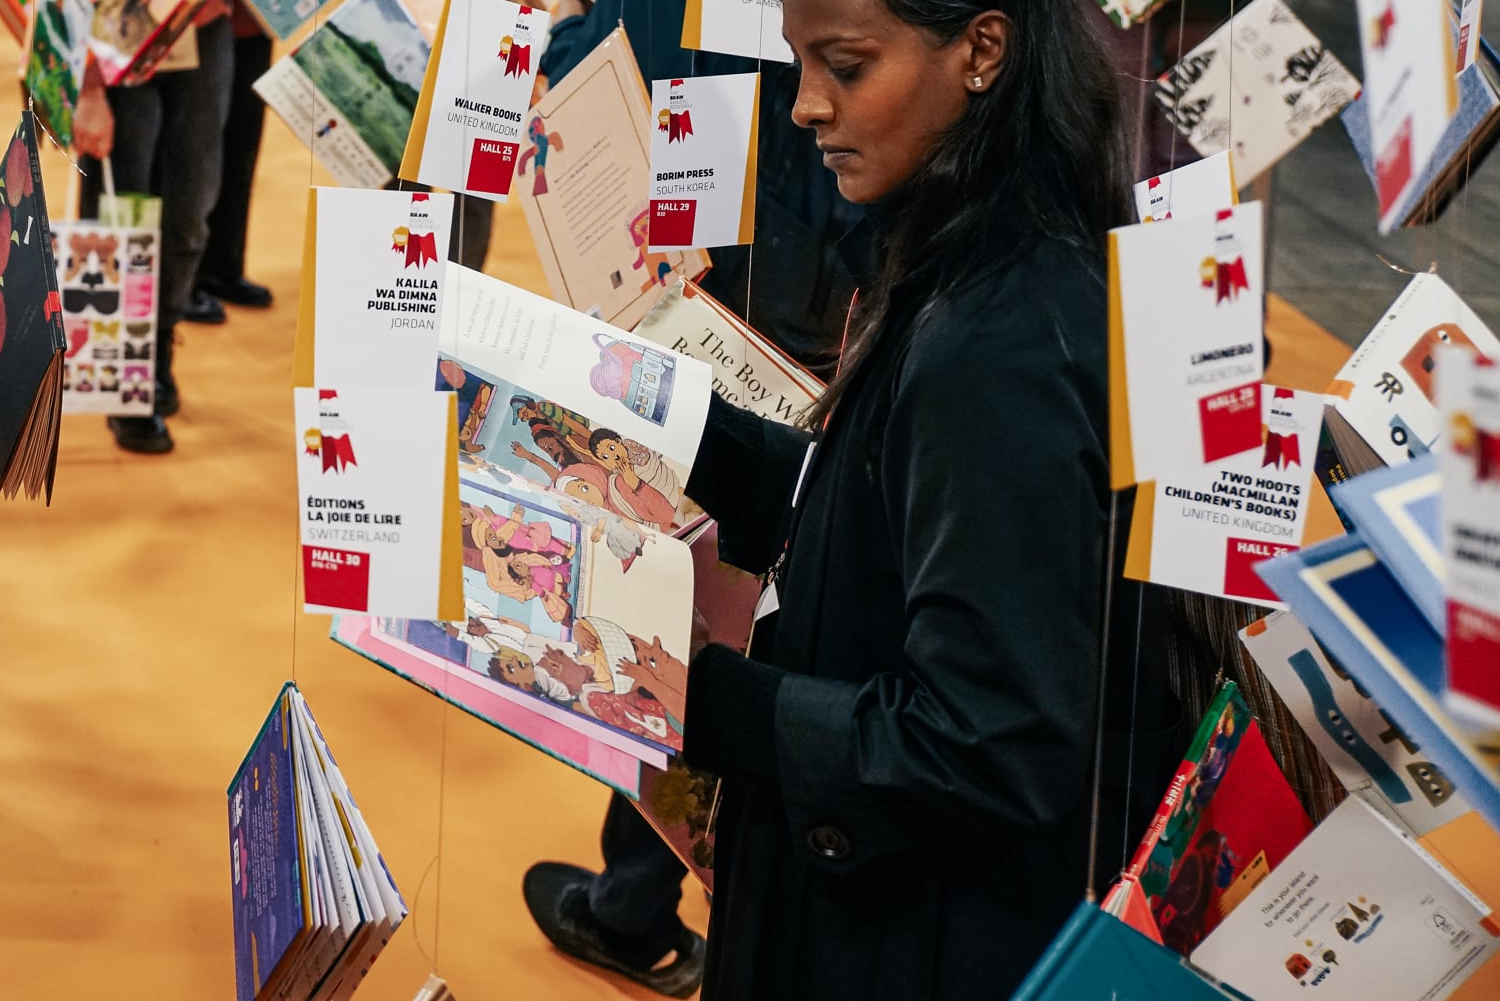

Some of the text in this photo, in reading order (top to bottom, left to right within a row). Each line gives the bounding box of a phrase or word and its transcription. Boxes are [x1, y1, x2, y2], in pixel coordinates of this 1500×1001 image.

[515, 23, 529, 31] BRAW
[454, 97, 522, 123] WALKER BOOKS
[447, 111, 518, 138] UNITED KINGDOM
[480, 142, 513, 156] HALL 25
[656, 168, 714, 182] BORIM PRESS
[656, 181, 716, 196] SOUTH KOREA
[657, 202, 690, 211] HALL 29
[395, 277, 439, 290] KALILA
[375, 288, 437, 302] WA DIMNA
[367, 300, 436, 314] PUBLISHING
[390, 317, 435, 330] JORDAN
[1190, 342, 1254, 366] LIMONERO
[698, 327, 773, 402] The Boy
[1186, 363, 1254, 386] ARGENTINA
[1206, 392, 1238, 412] HALL
[1220, 470, 1300, 495] TWO HOOTS
[306, 494, 365, 510] ÉDITIONS
[1212, 481, 1299, 509] (MACMILLAN
[1164, 486, 1297, 522] CHILDREN'S BOOKS)
[307, 511, 402, 525] LA JOIE DE LIRE
[1182, 506, 1294, 538] UNITED KINGDOM
[308, 527, 400, 544] SWITZERLAND
[311, 549, 361, 566] HALL 30
[1237, 541, 1271, 557] HALL
[1261, 903, 1275, 914] This
[1278, 887, 1291, 900] your
[1289, 870, 1306, 888] island
[1264, 874, 1320, 928] for whenever you want
[1286, 916, 1294, 924] to
[1293, 909, 1301, 920] go
